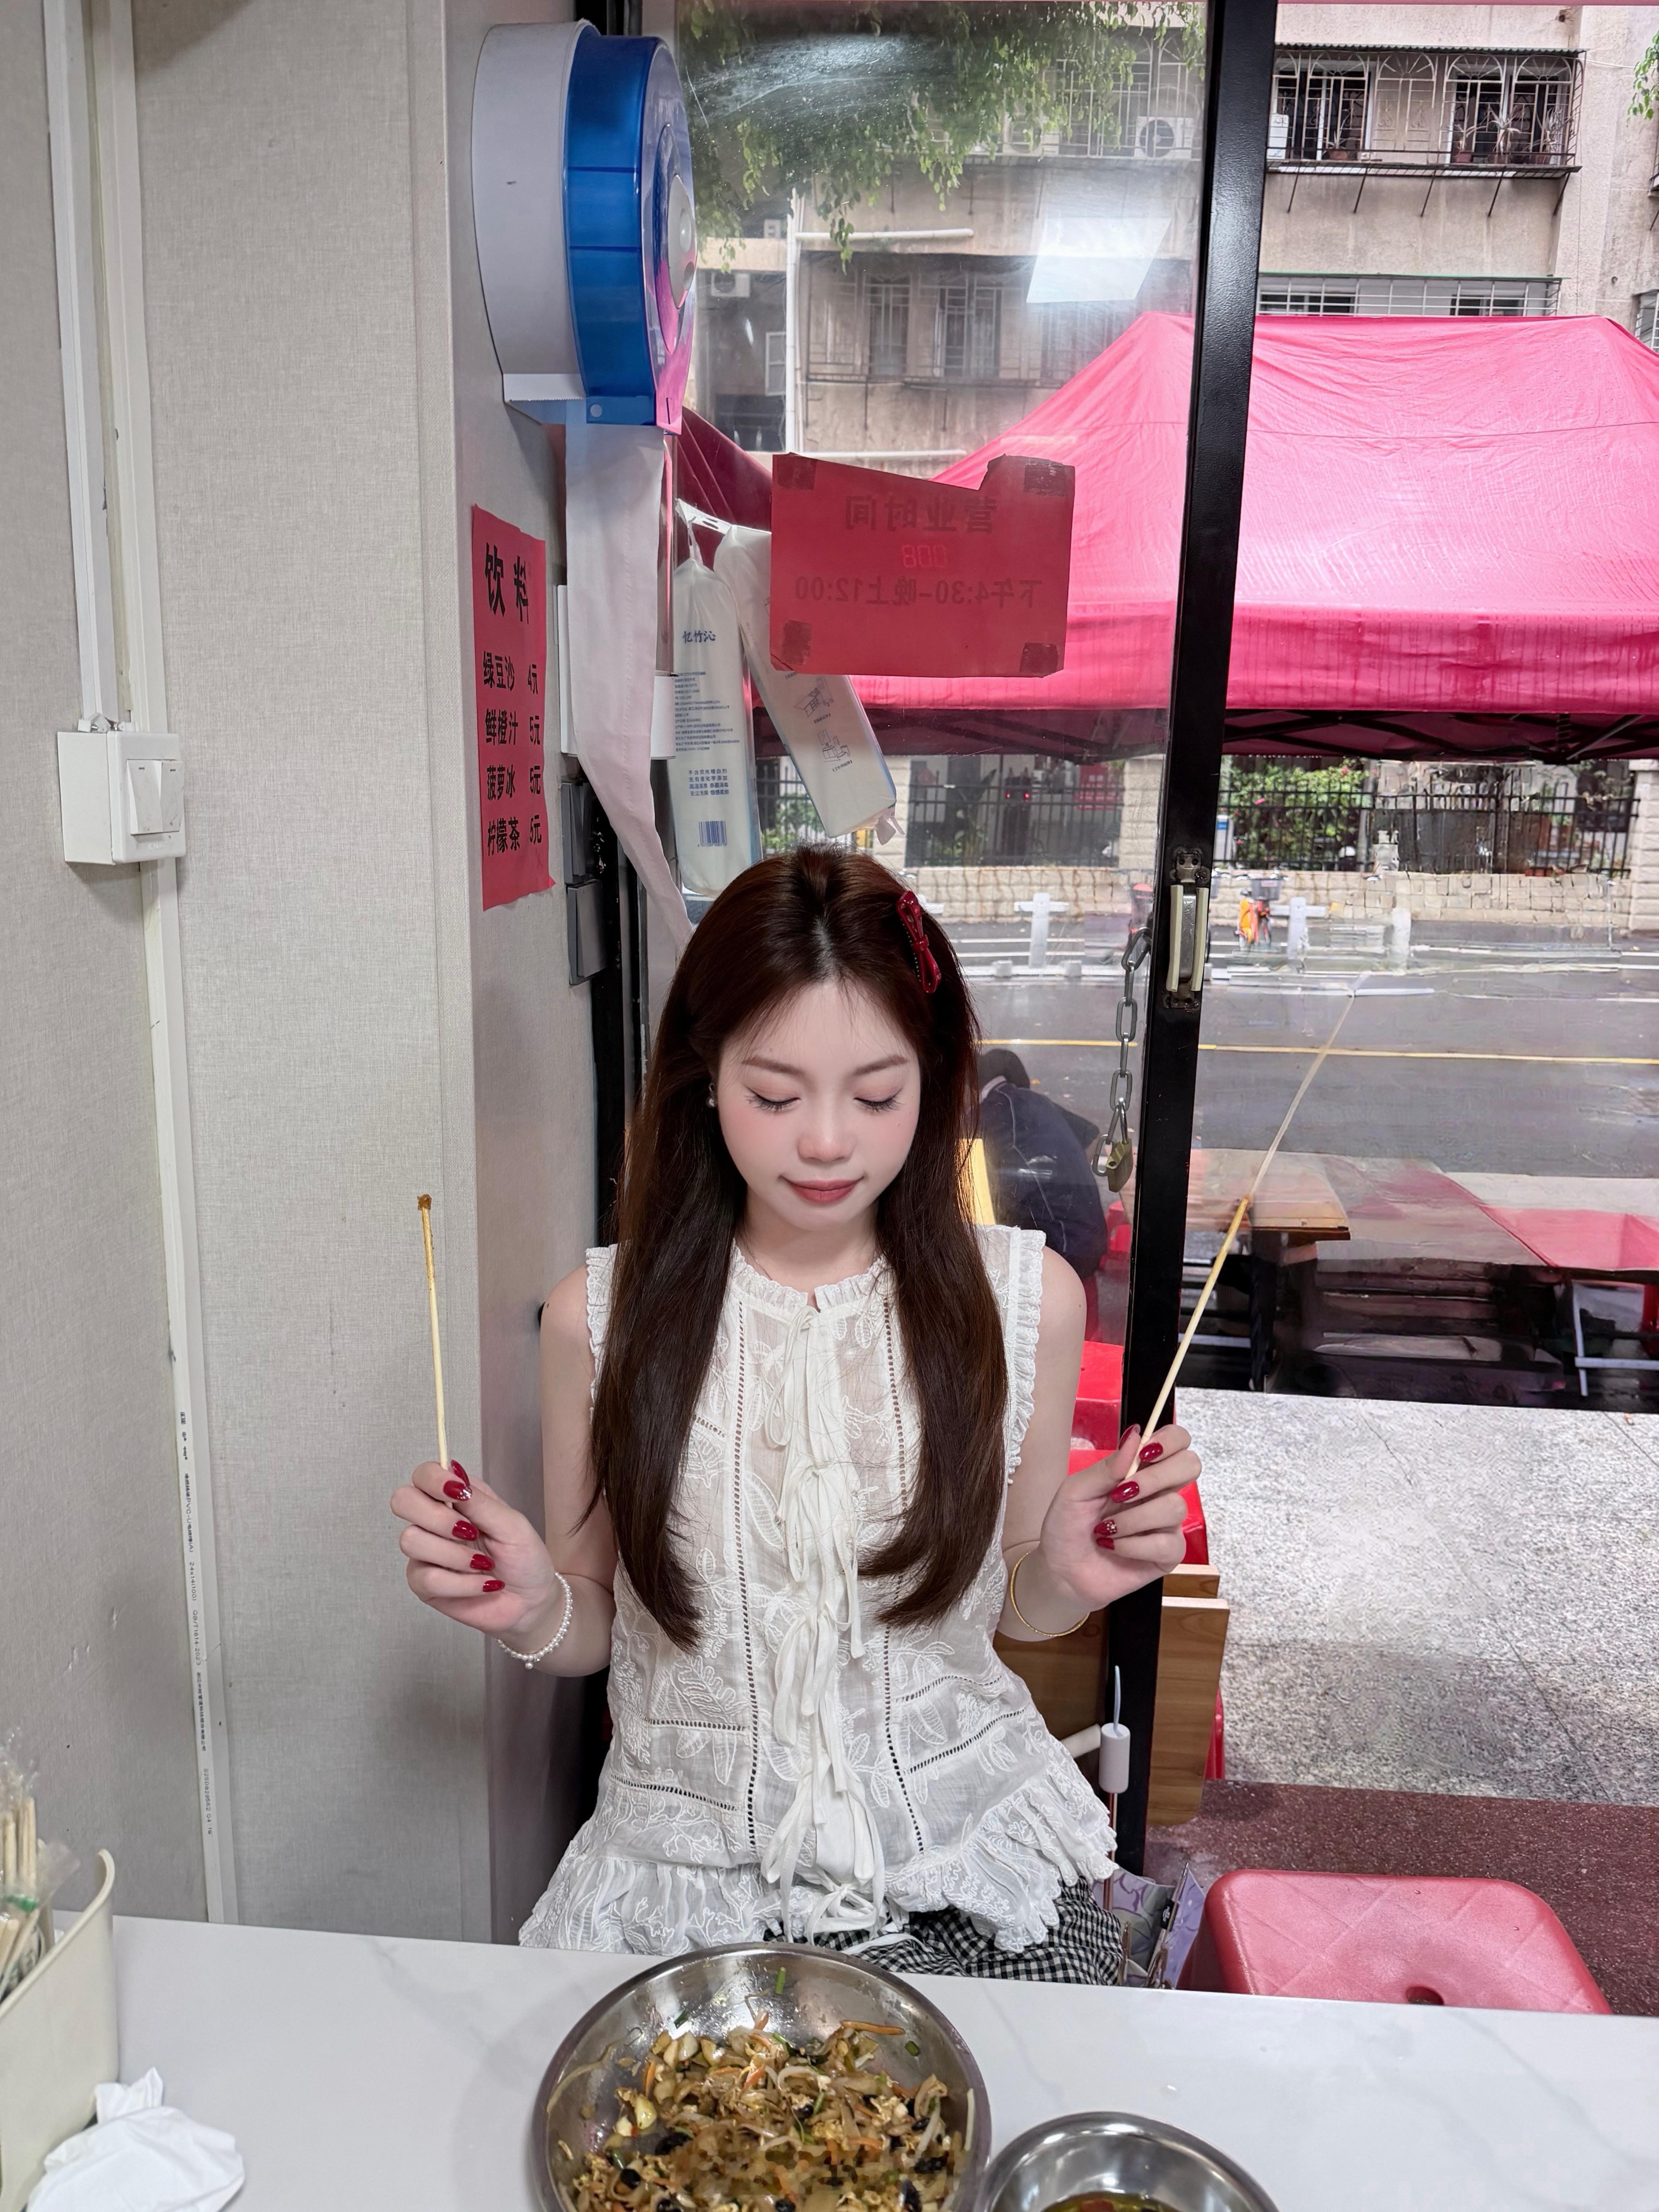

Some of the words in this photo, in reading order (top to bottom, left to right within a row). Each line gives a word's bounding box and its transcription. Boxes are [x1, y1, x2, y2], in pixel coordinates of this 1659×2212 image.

[484, 542, 529, 625] 饮料
[682, 630, 716, 644] 忆竹沁
[483, 650, 515, 691] 绿豆沙
[527, 663, 538, 694] 4元
[485, 708, 518, 745] 鲜橙汁
[529, 715, 540, 745] 5元
[486, 764, 515, 801] 菠萝冰
[529, 765, 541, 795] 5元
[487, 814, 520, 856] 柠檬茶
[529, 814, 542, 845] 5元
